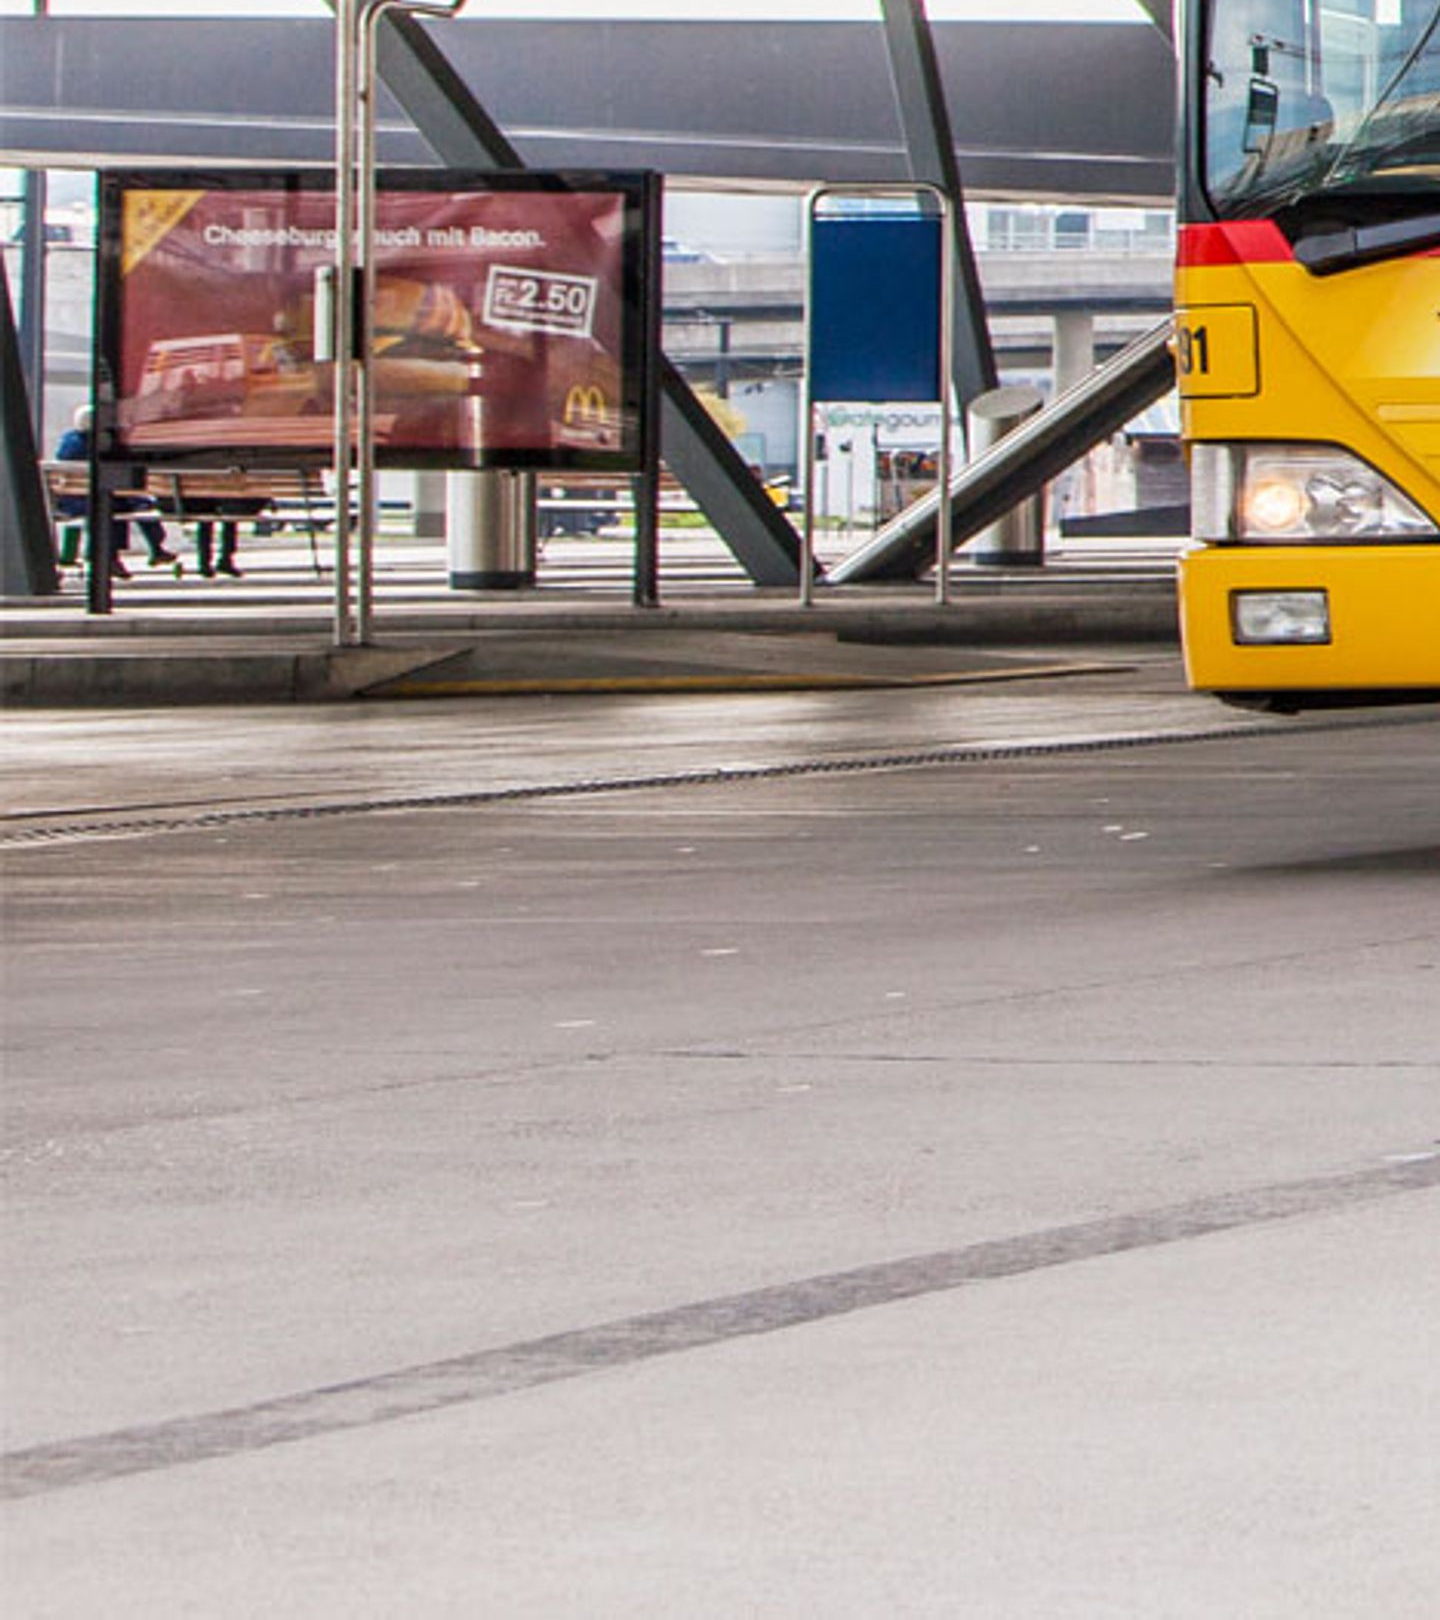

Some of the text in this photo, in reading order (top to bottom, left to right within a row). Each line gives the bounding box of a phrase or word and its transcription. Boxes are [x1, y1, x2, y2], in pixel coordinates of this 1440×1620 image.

[204, 226, 361, 252] Cheeseburg
[427, 227, 464, 247] mit
[519, 279, 587, 314] 2.50
